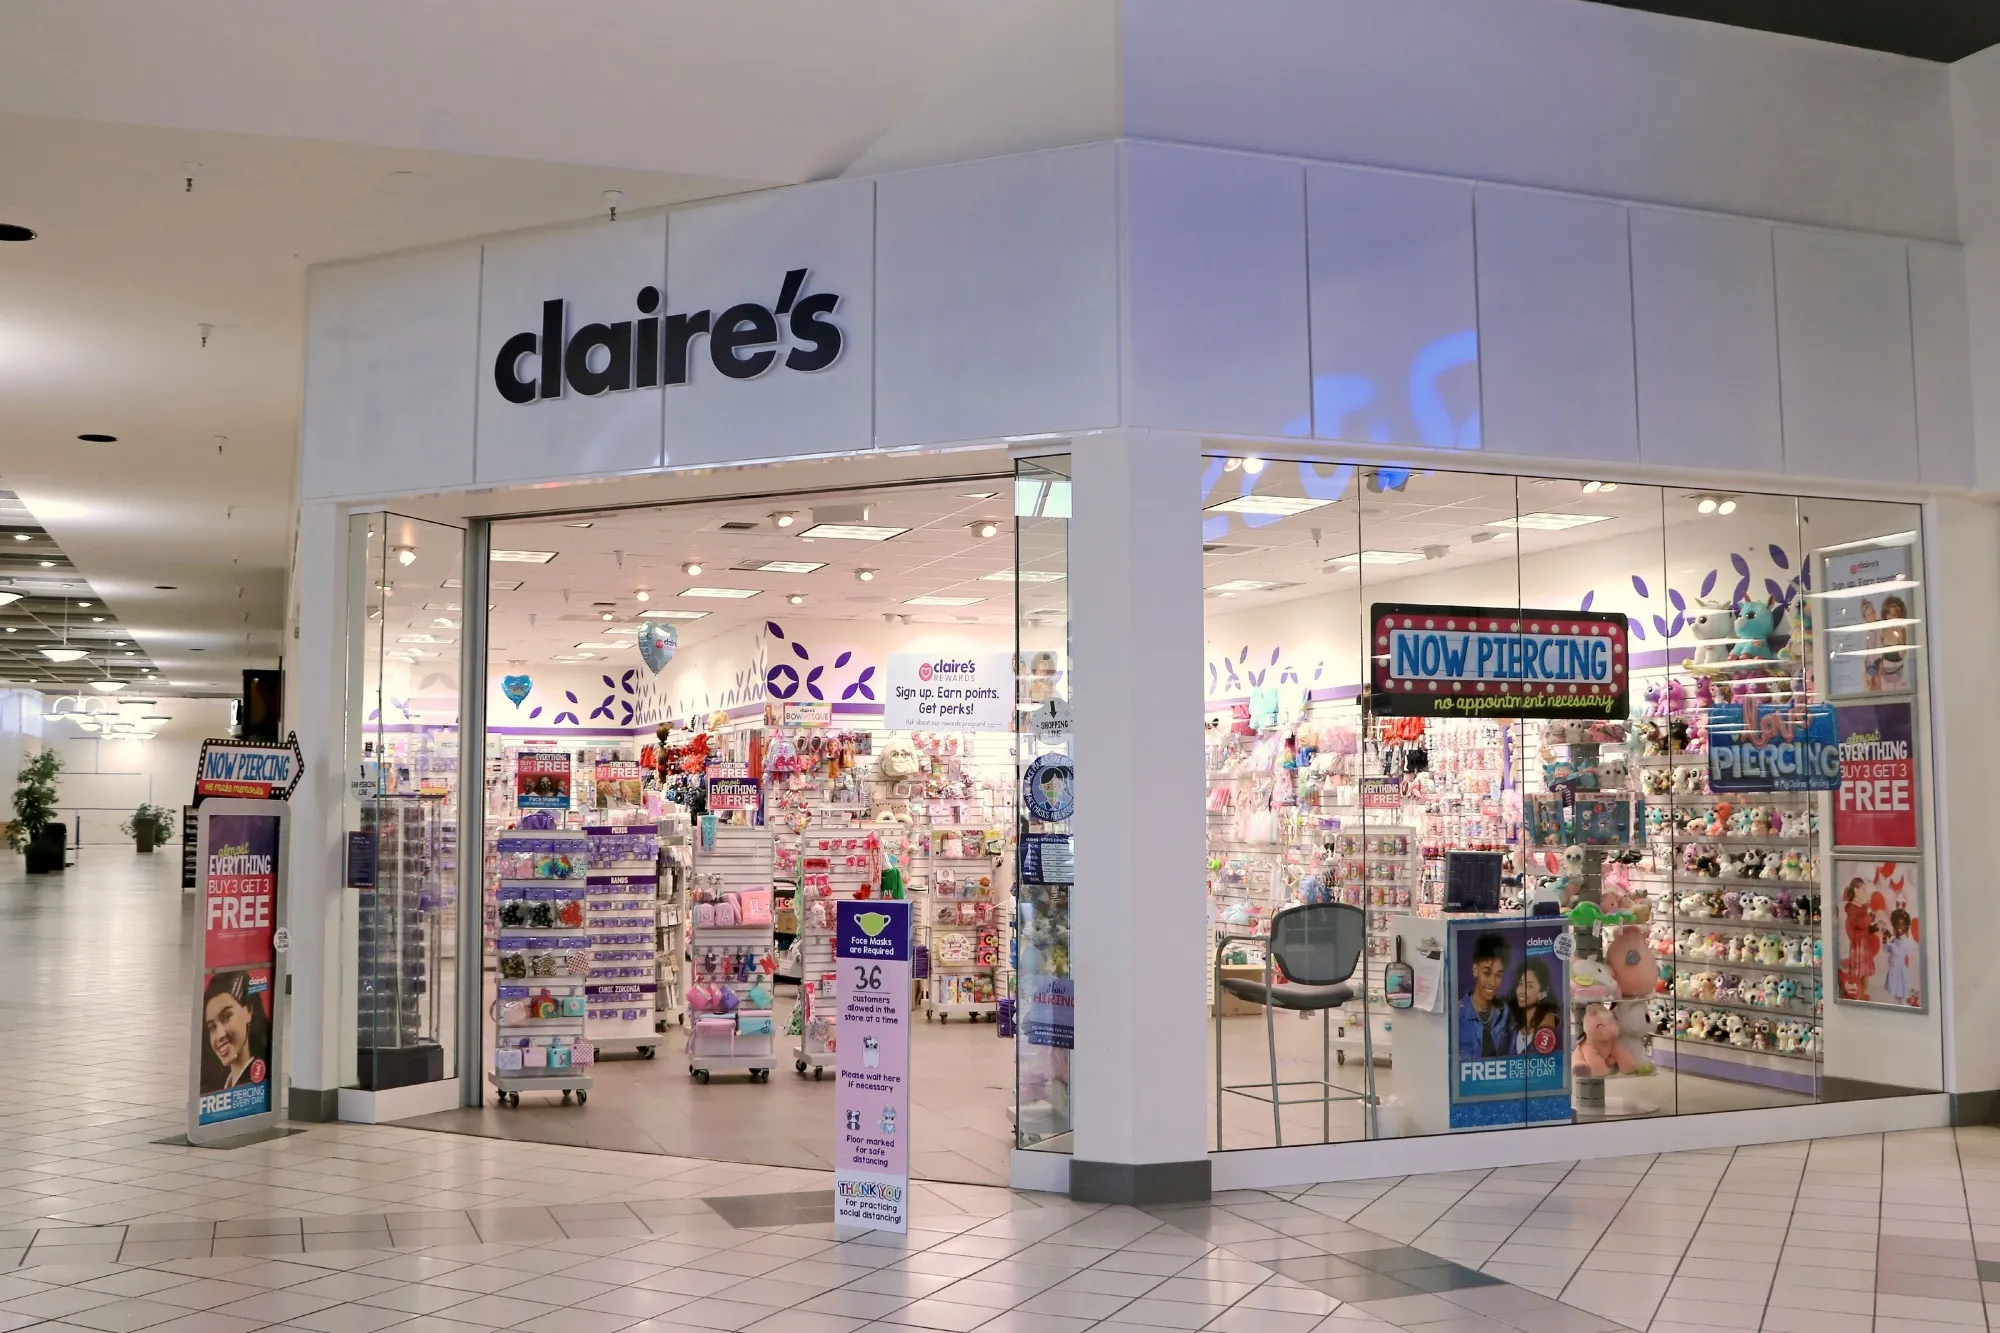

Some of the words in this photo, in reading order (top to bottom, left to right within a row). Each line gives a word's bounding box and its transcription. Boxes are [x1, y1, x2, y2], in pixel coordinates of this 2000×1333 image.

[494, 267, 844, 404] claire's
[1396, 633, 1470, 677] NOW
[1477, 636, 1607, 680] PIERCING
[933, 659, 976, 673] claire's
[933, 674, 976, 682] REWARDS
[896, 686, 917, 699] Sign
[919, 688, 934, 699] up.
[937, 687, 962, 698] Earn
[965, 687, 1000, 701] points.
[919, 702, 936, 714] Get
[940, 702, 974, 716] perks!
[1434, 698, 1454, 710] no
[1457, 692, 1546, 715] appointment
[1548, 692, 1614, 713] necessary
[905, 718, 915, 726] Ask
[1040, 720, 1069, 729] SHOPPING
[1846, 729, 1881, 745] almost
[536, 753, 567, 761] EVERYTHING
[1839, 741, 1908, 762] EVERYTHING
[205, 751, 239, 780] NOW
[237, 753, 290, 781] PIERCING
[536, 761, 569, 772] FREE
[1710, 742, 1840, 780] PIERCING
[611, 768, 639, 778] FREE
[721, 769, 748, 778] FREE
[1840, 764, 1861, 778] BUY
[1863, 764, 1870, 777] 3
[1873, 764, 1897, 777] GET
[1900, 763, 1907, 777] 3
[205, 782, 213, 790] we
[214, 781, 232, 792] make
[711, 784, 757, 795] EVERYTHING
[727, 795, 757, 806] FREE
[1374, 794, 1399, 804] FREE
[1840, 780, 1910, 811] FREE
[217, 841, 250, 857] almost
[208, 854, 272, 876] EVERYTHING
[208, 879, 231, 893] BUY
[232, 879, 239, 893] 3
[240, 879, 262, 893] GET
[263, 878, 270, 893] 3
[207, 894, 271, 930] FREE
[851, 936, 868, 945] Face
[869, 937, 892, 946] Masks
[1526, 937, 1554, 946] claire's
[863, 946, 895, 956] Required
[854, 964, 882, 990] 36
[615, 985, 641, 993] ZIRCONIA
[852, 994, 891, 1004] customers
[847, 1005, 874, 1013] allowed
[875, 1005, 882, 1013] in
[884, 1006, 896, 1014] the
[844, 1014, 864, 1022] store
[882, 1015, 898, 1024] time
[1541, 1035, 1549, 1046] 3
[255, 1063, 261, 1076] 3
[1509, 1056, 1556, 1071] PIERCING
[841, 1069, 864, 1080] Please
[866, 1071, 882, 1081] wait
[883, 1073, 901, 1082] here
[1461, 1060, 1507, 1082] FREE
[1509, 1069, 1535, 1079] EVERY
[1536, 1067, 1555, 1077] DAY!
[232, 1085, 265, 1101] PIERCING
[848, 1080, 855, 1088] if
[856, 1082, 894, 1093] necessary
[199, 1092, 232, 1116] FREE
[232, 1098, 251, 1109] EVERY
[846, 1134, 865, 1144] Floor
[866, 1137, 895, 1147] marked
[855, 1145, 867, 1154] for
[869, 1147, 885, 1156] safe
[852, 1155, 889, 1167] distancing
[838, 1181, 879, 1197] THANK
[878, 1184, 902, 1202] YOU
[845, 1198, 857, 1207] for
[860, 1201, 898, 1213] practicing
[839, 1208, 861, 1217] social
[862, 1210, 902, 1224] distancing!
